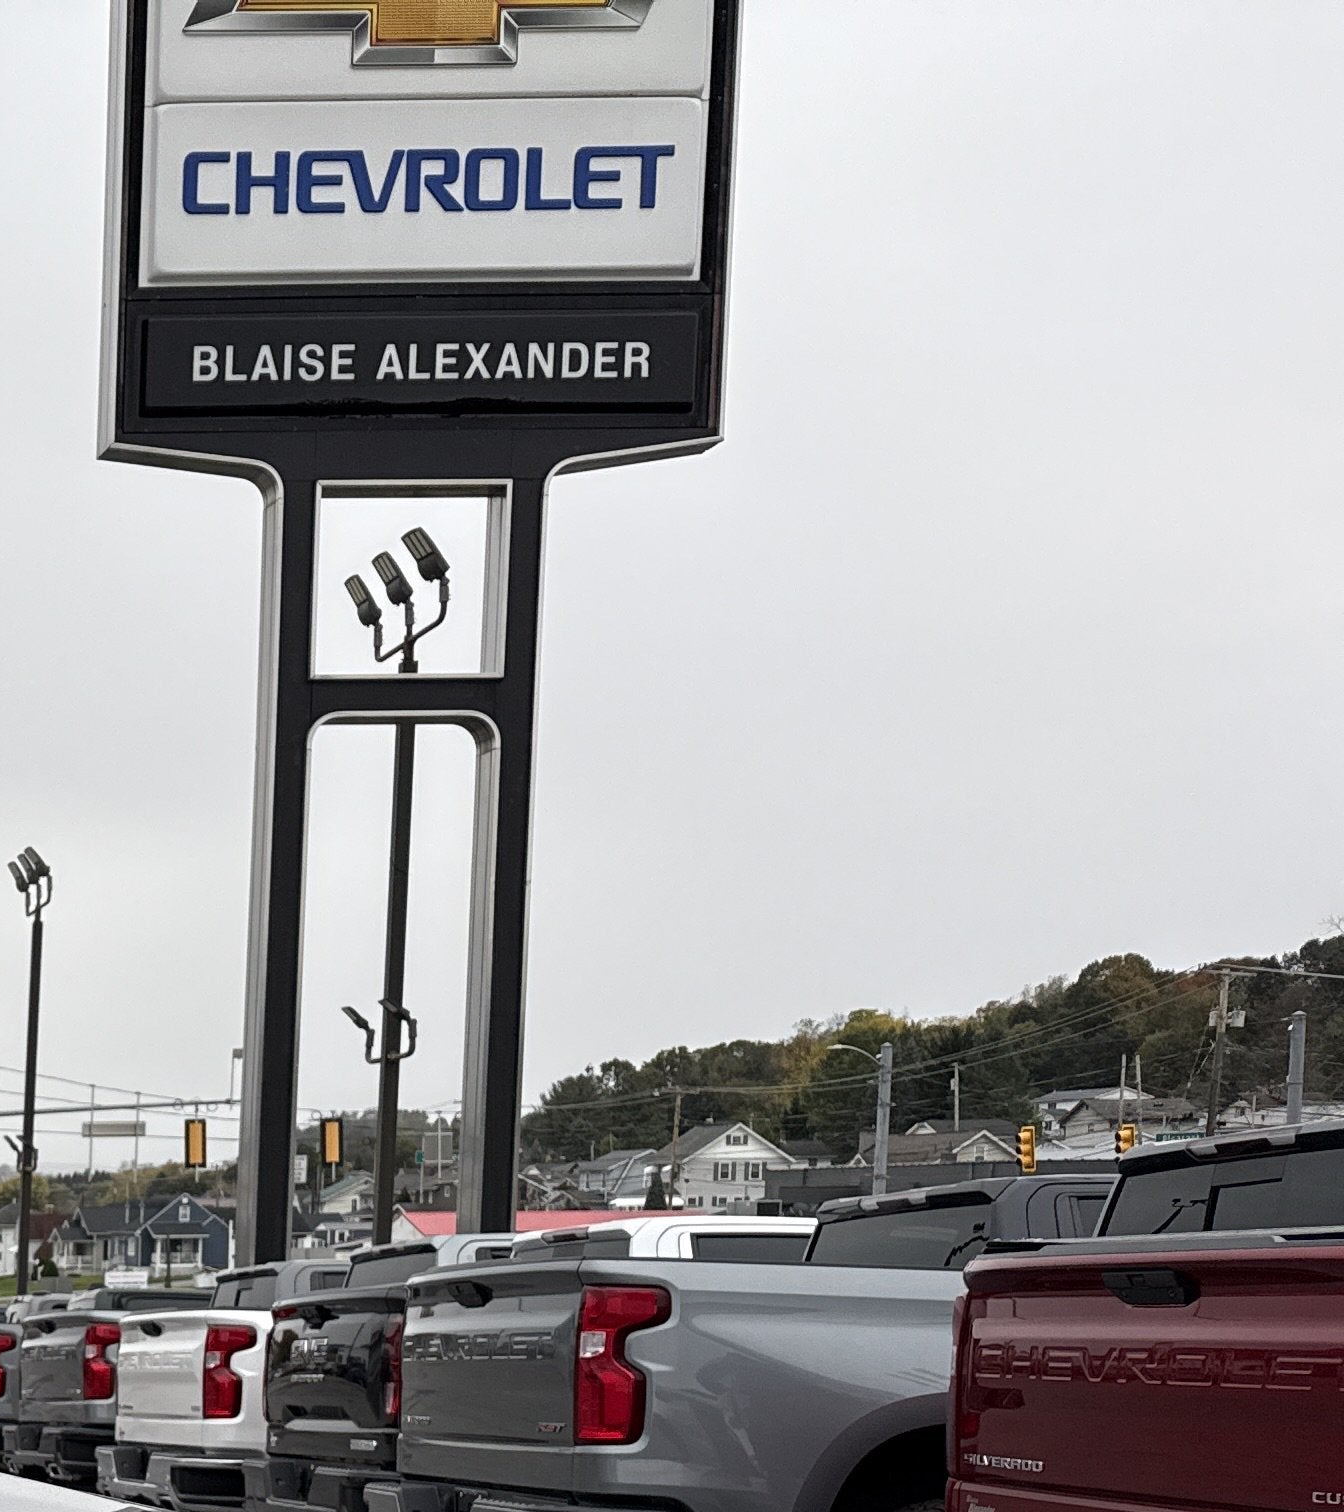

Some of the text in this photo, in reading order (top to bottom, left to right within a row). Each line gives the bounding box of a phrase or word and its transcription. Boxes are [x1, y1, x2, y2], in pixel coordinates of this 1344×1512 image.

[182, 144, 676, 215] CHEVROLET
[191, 341, 651, 382] BLAISE ALEXANDER
[964, 1453, 1044, 1473] SILVERADO
[1312, 1491, 1344, 1506] CU
